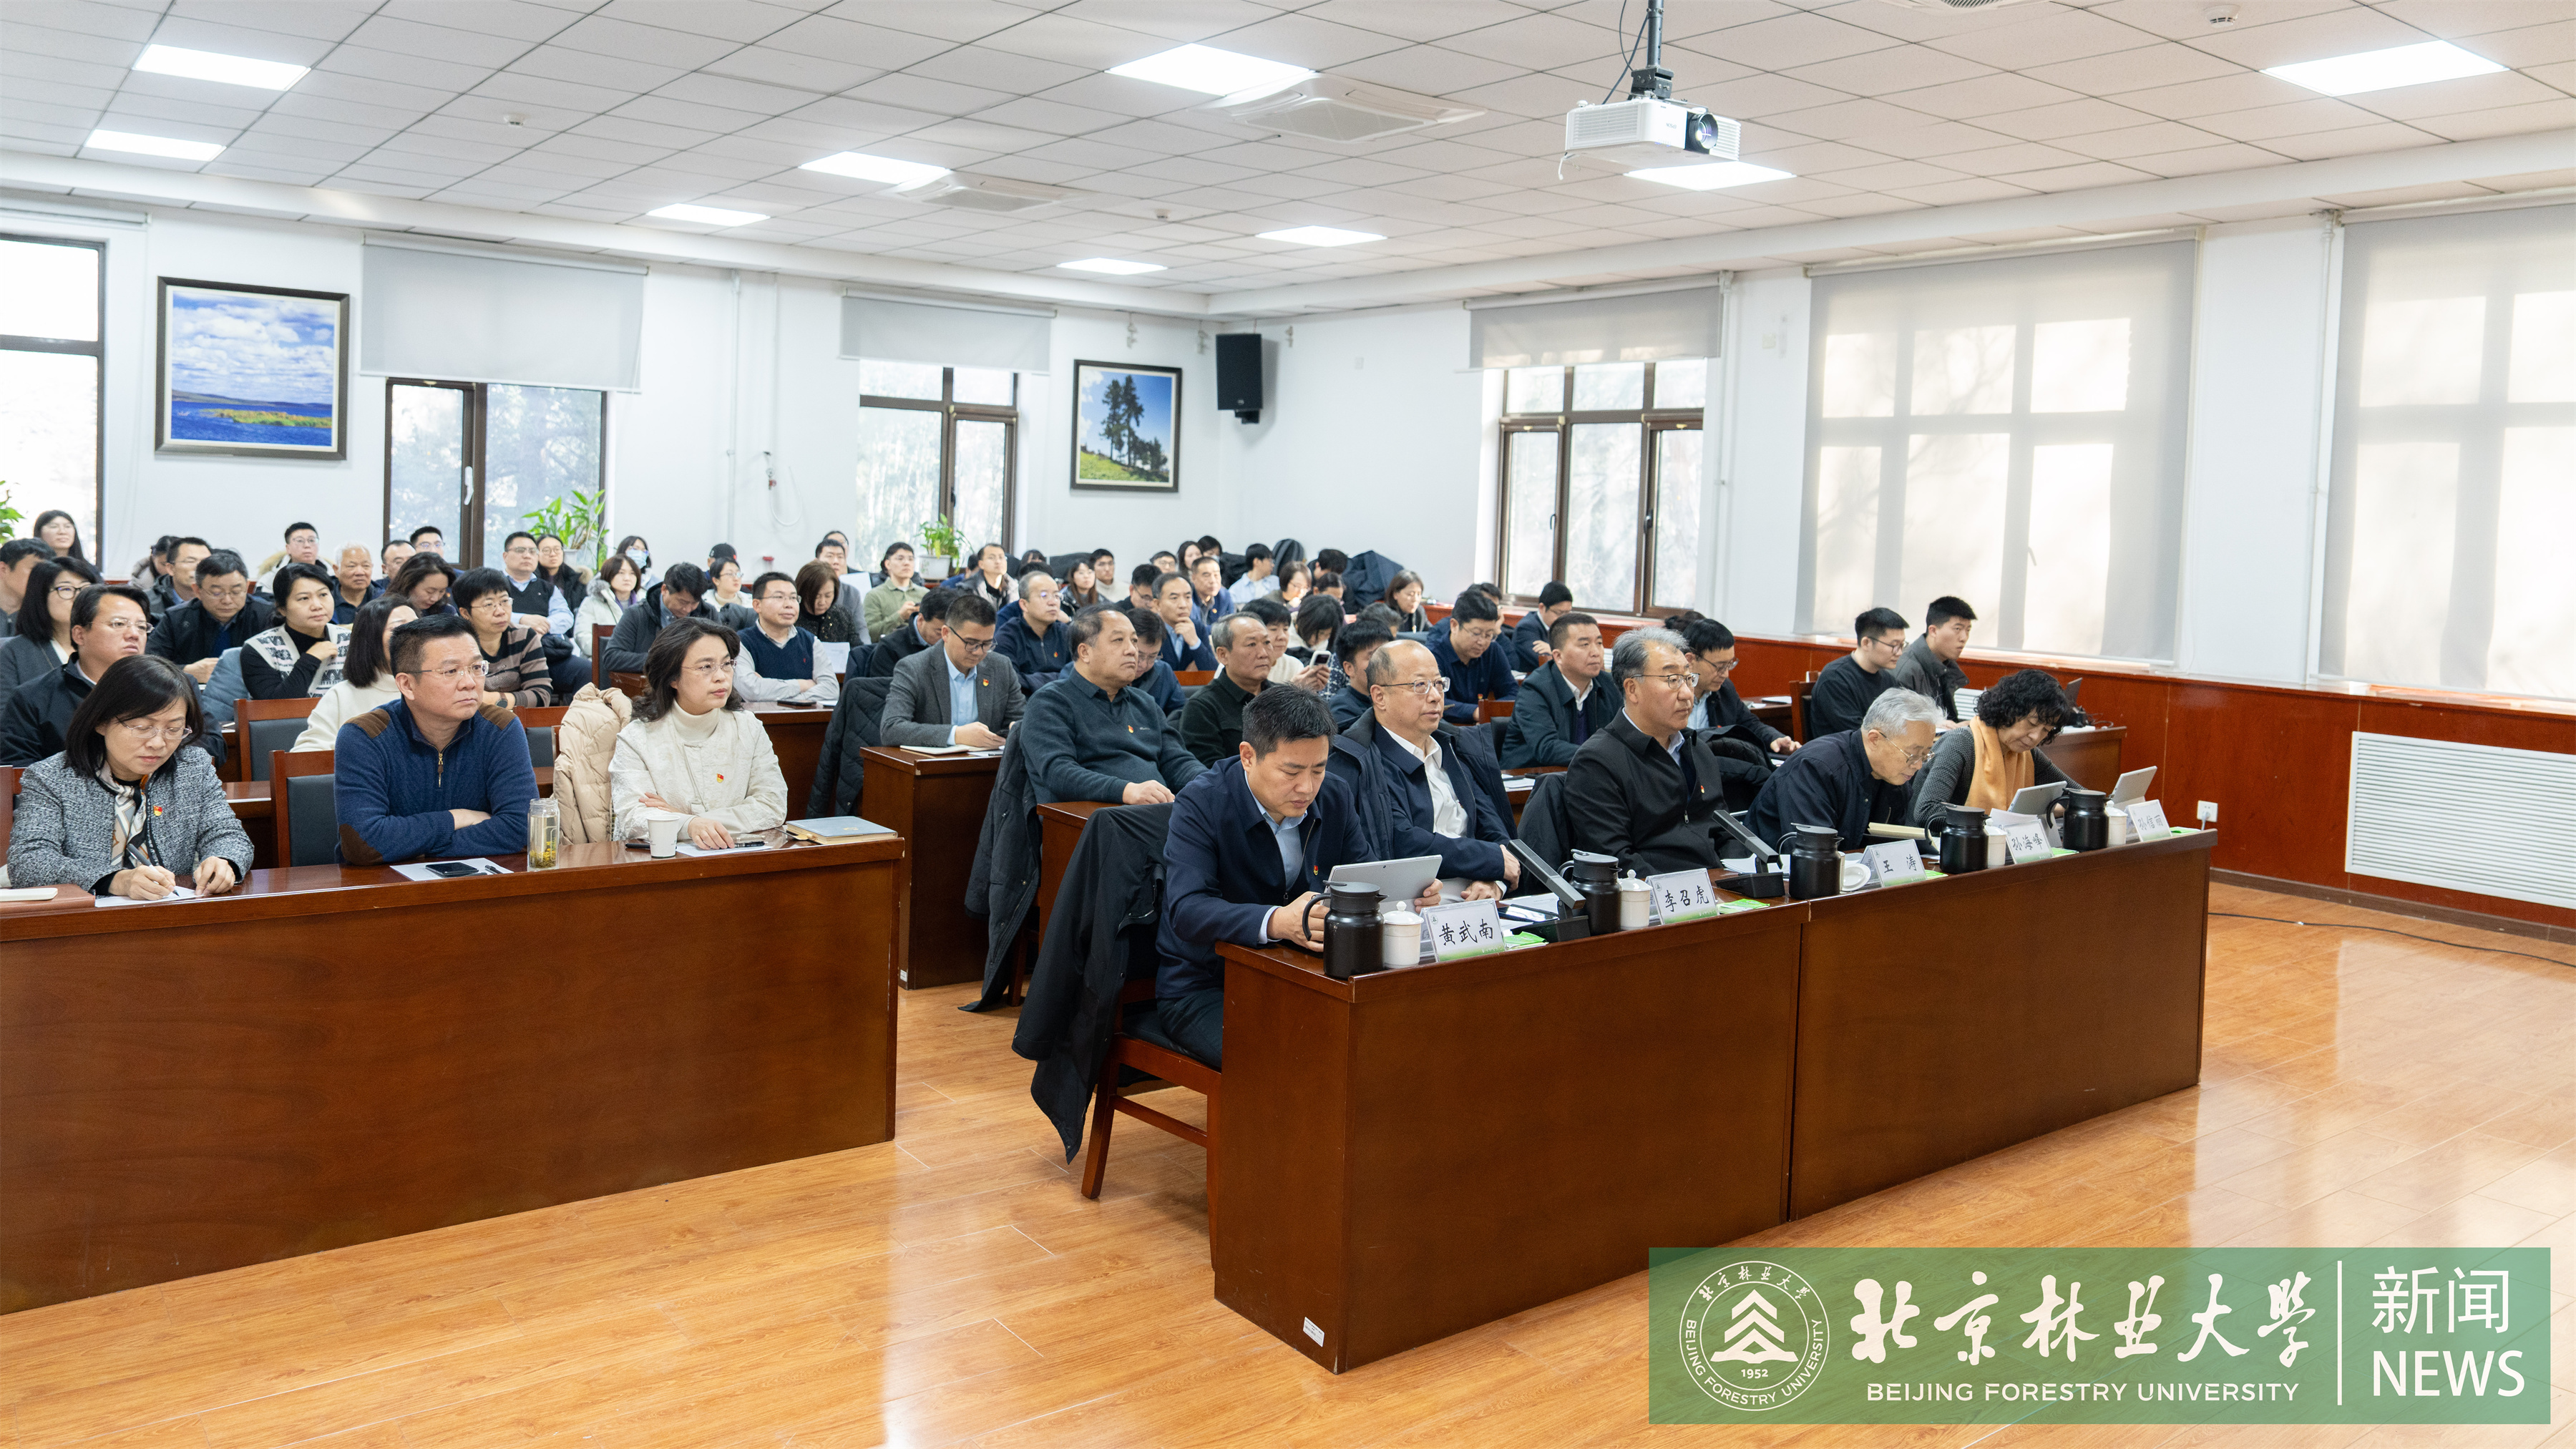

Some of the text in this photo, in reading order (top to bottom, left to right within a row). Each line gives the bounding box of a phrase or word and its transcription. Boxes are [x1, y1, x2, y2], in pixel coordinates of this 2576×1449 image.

[2011, 833, 2043, 851] 孙海峰
[1664, 884, 1709, 912] 李召虎
[1439, 918, 1493, 946] 黄武南
